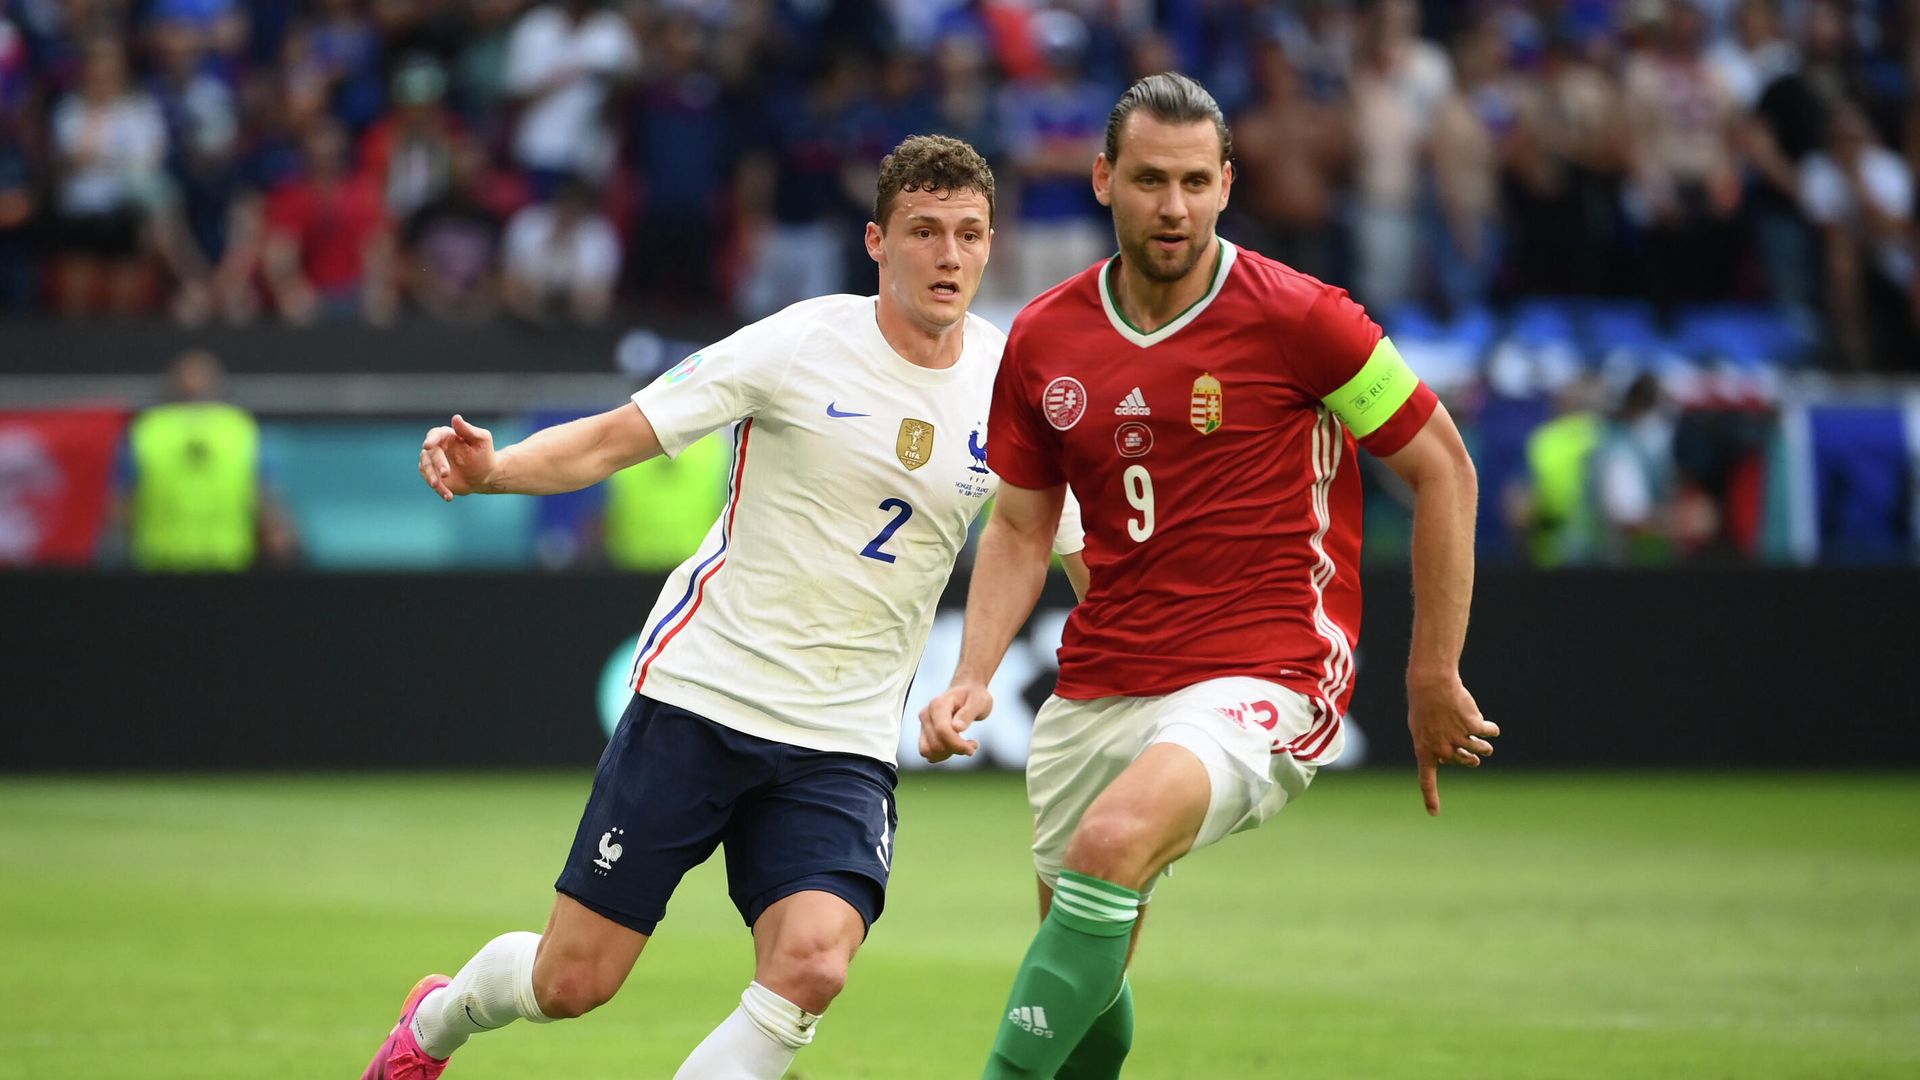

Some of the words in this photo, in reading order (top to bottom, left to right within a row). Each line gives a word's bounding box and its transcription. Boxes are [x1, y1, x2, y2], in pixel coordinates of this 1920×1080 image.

[1369, 367, 1396, 398] RESP
[904, 450, 920, 460] FIFA
[1123, 465, 1155, 543] 9
[859, 498, 913, 564] 2
[1008, 1009, 1054, 1038] adidas
